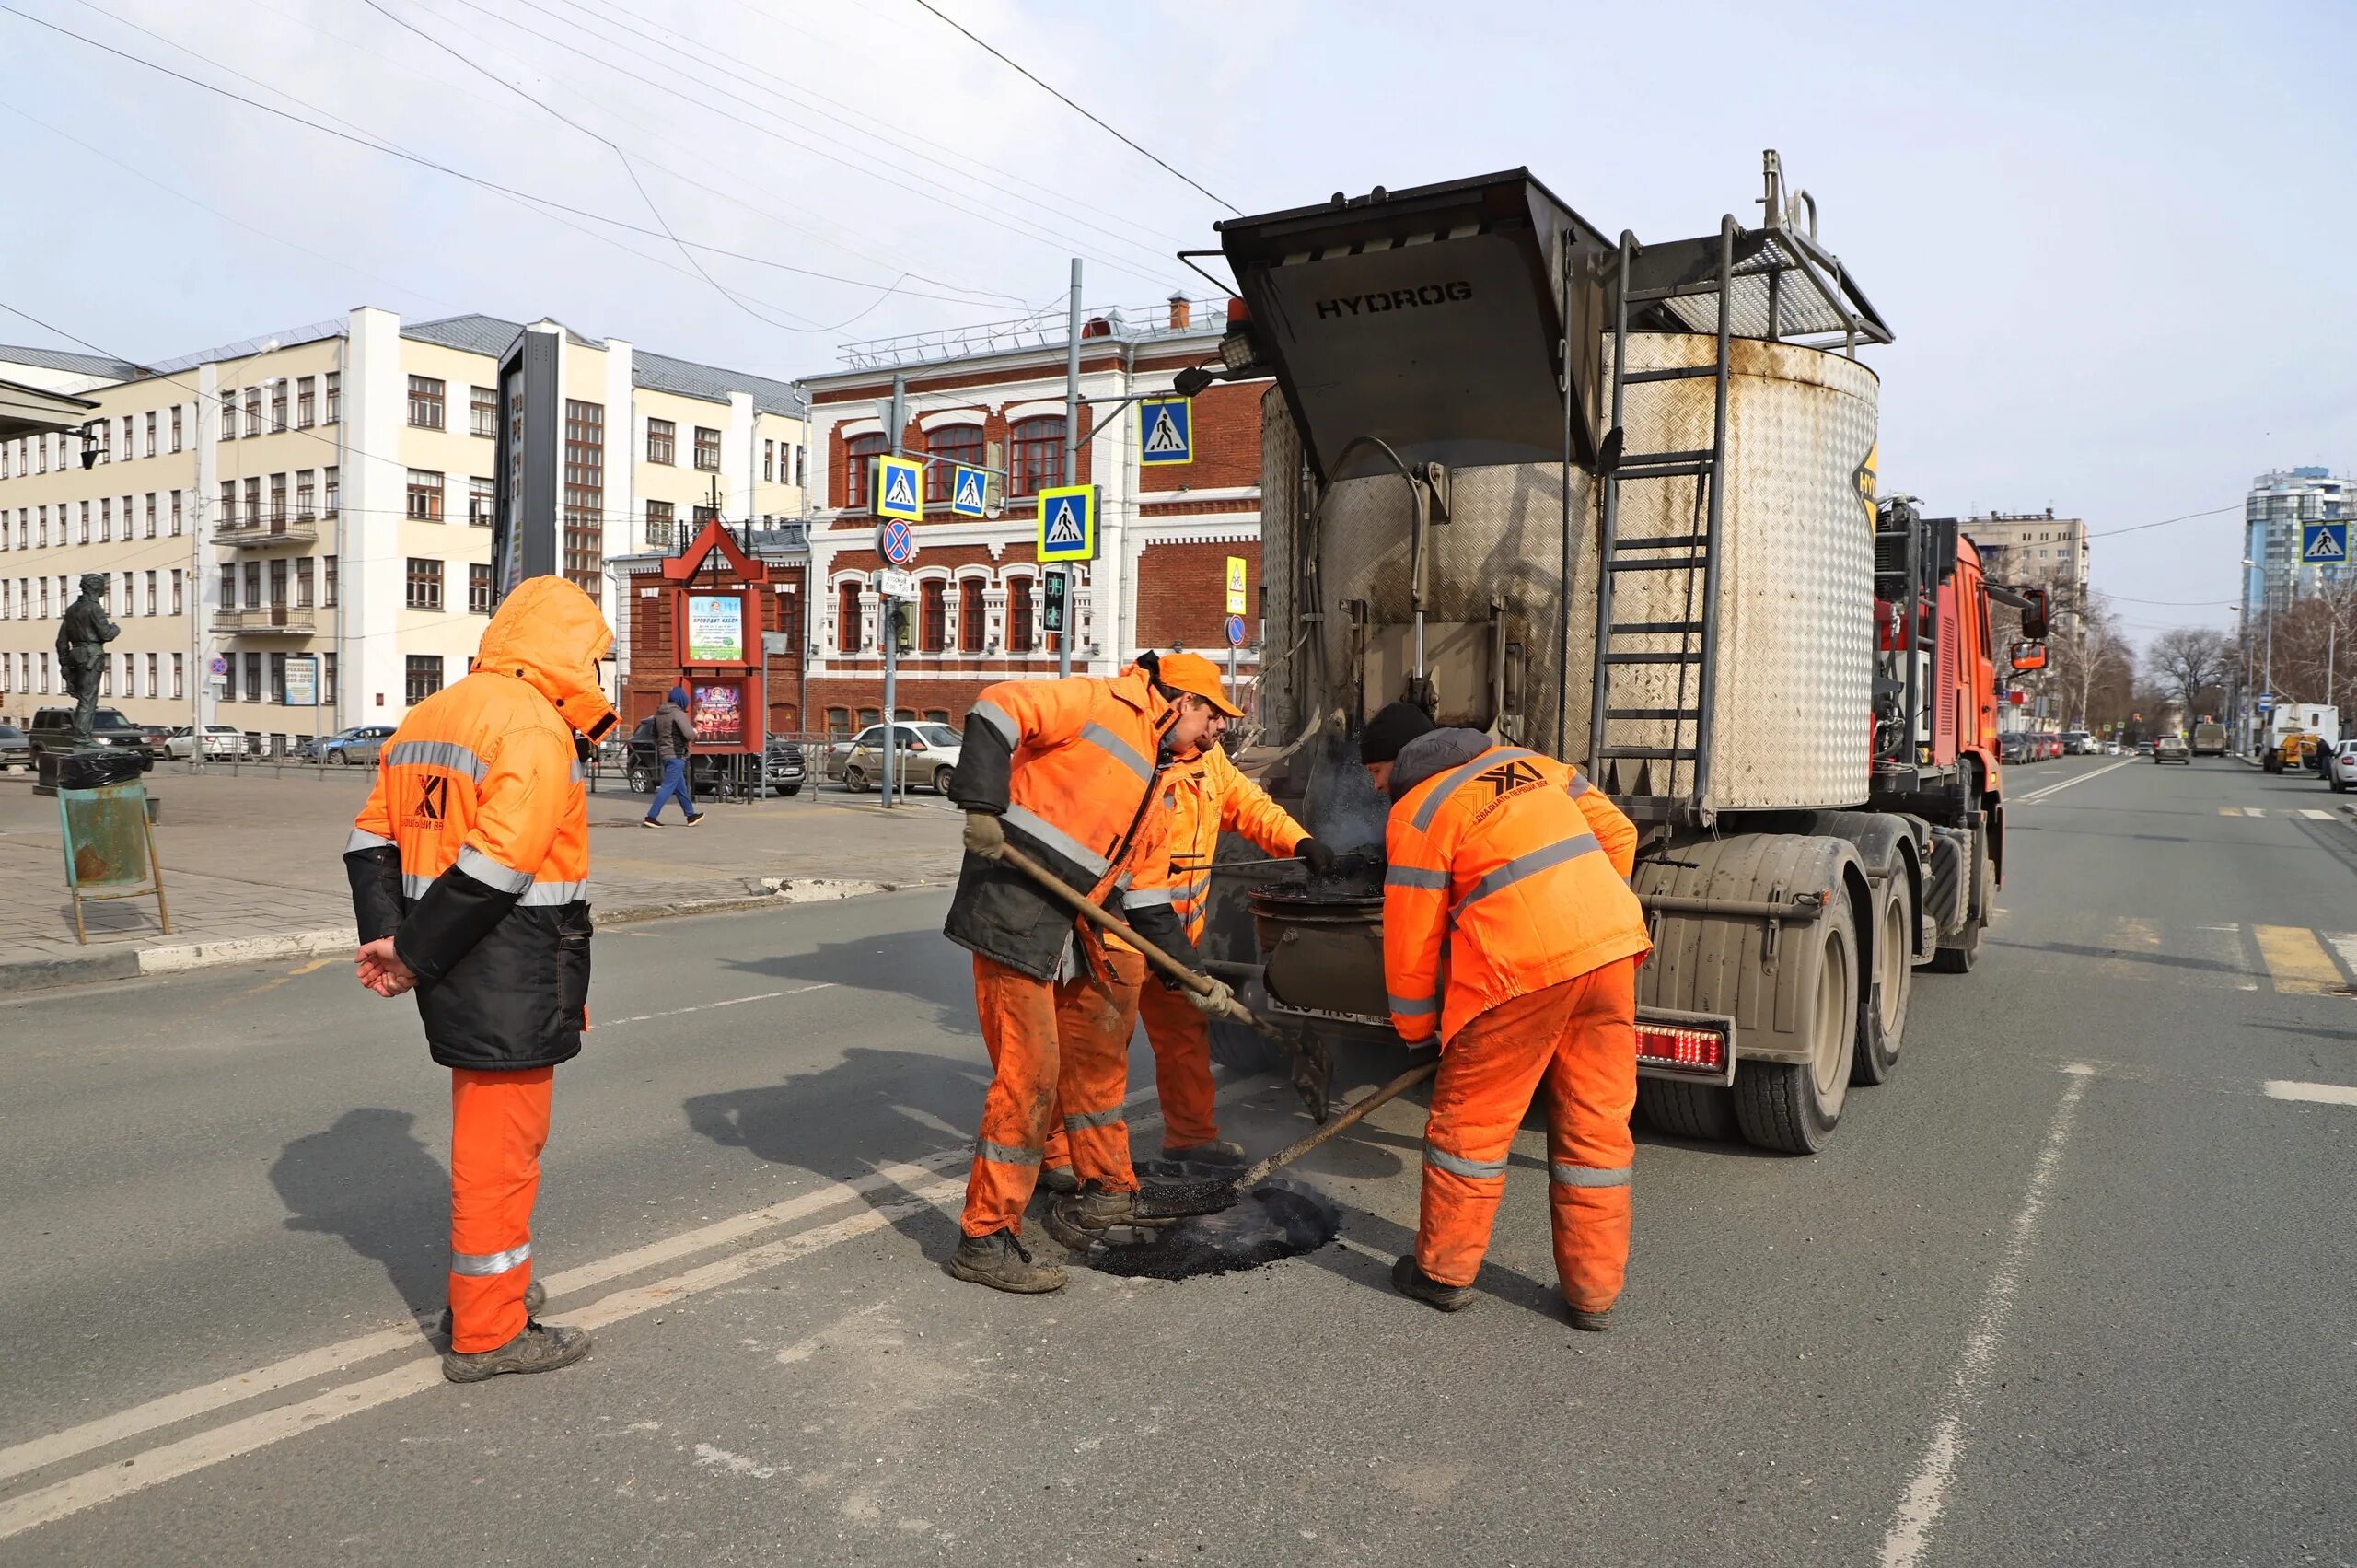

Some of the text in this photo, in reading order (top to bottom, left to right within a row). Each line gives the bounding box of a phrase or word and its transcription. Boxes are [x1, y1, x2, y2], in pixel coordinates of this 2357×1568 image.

[1315, 281, 1473, 319] HYDROG
[1475, 794, 1511, 824] ДВАДЦАТЬ
[1510, 783, 1537, 797] ПЕРВЫЙ
[1366, 1015, 1384, 1024] RUS
